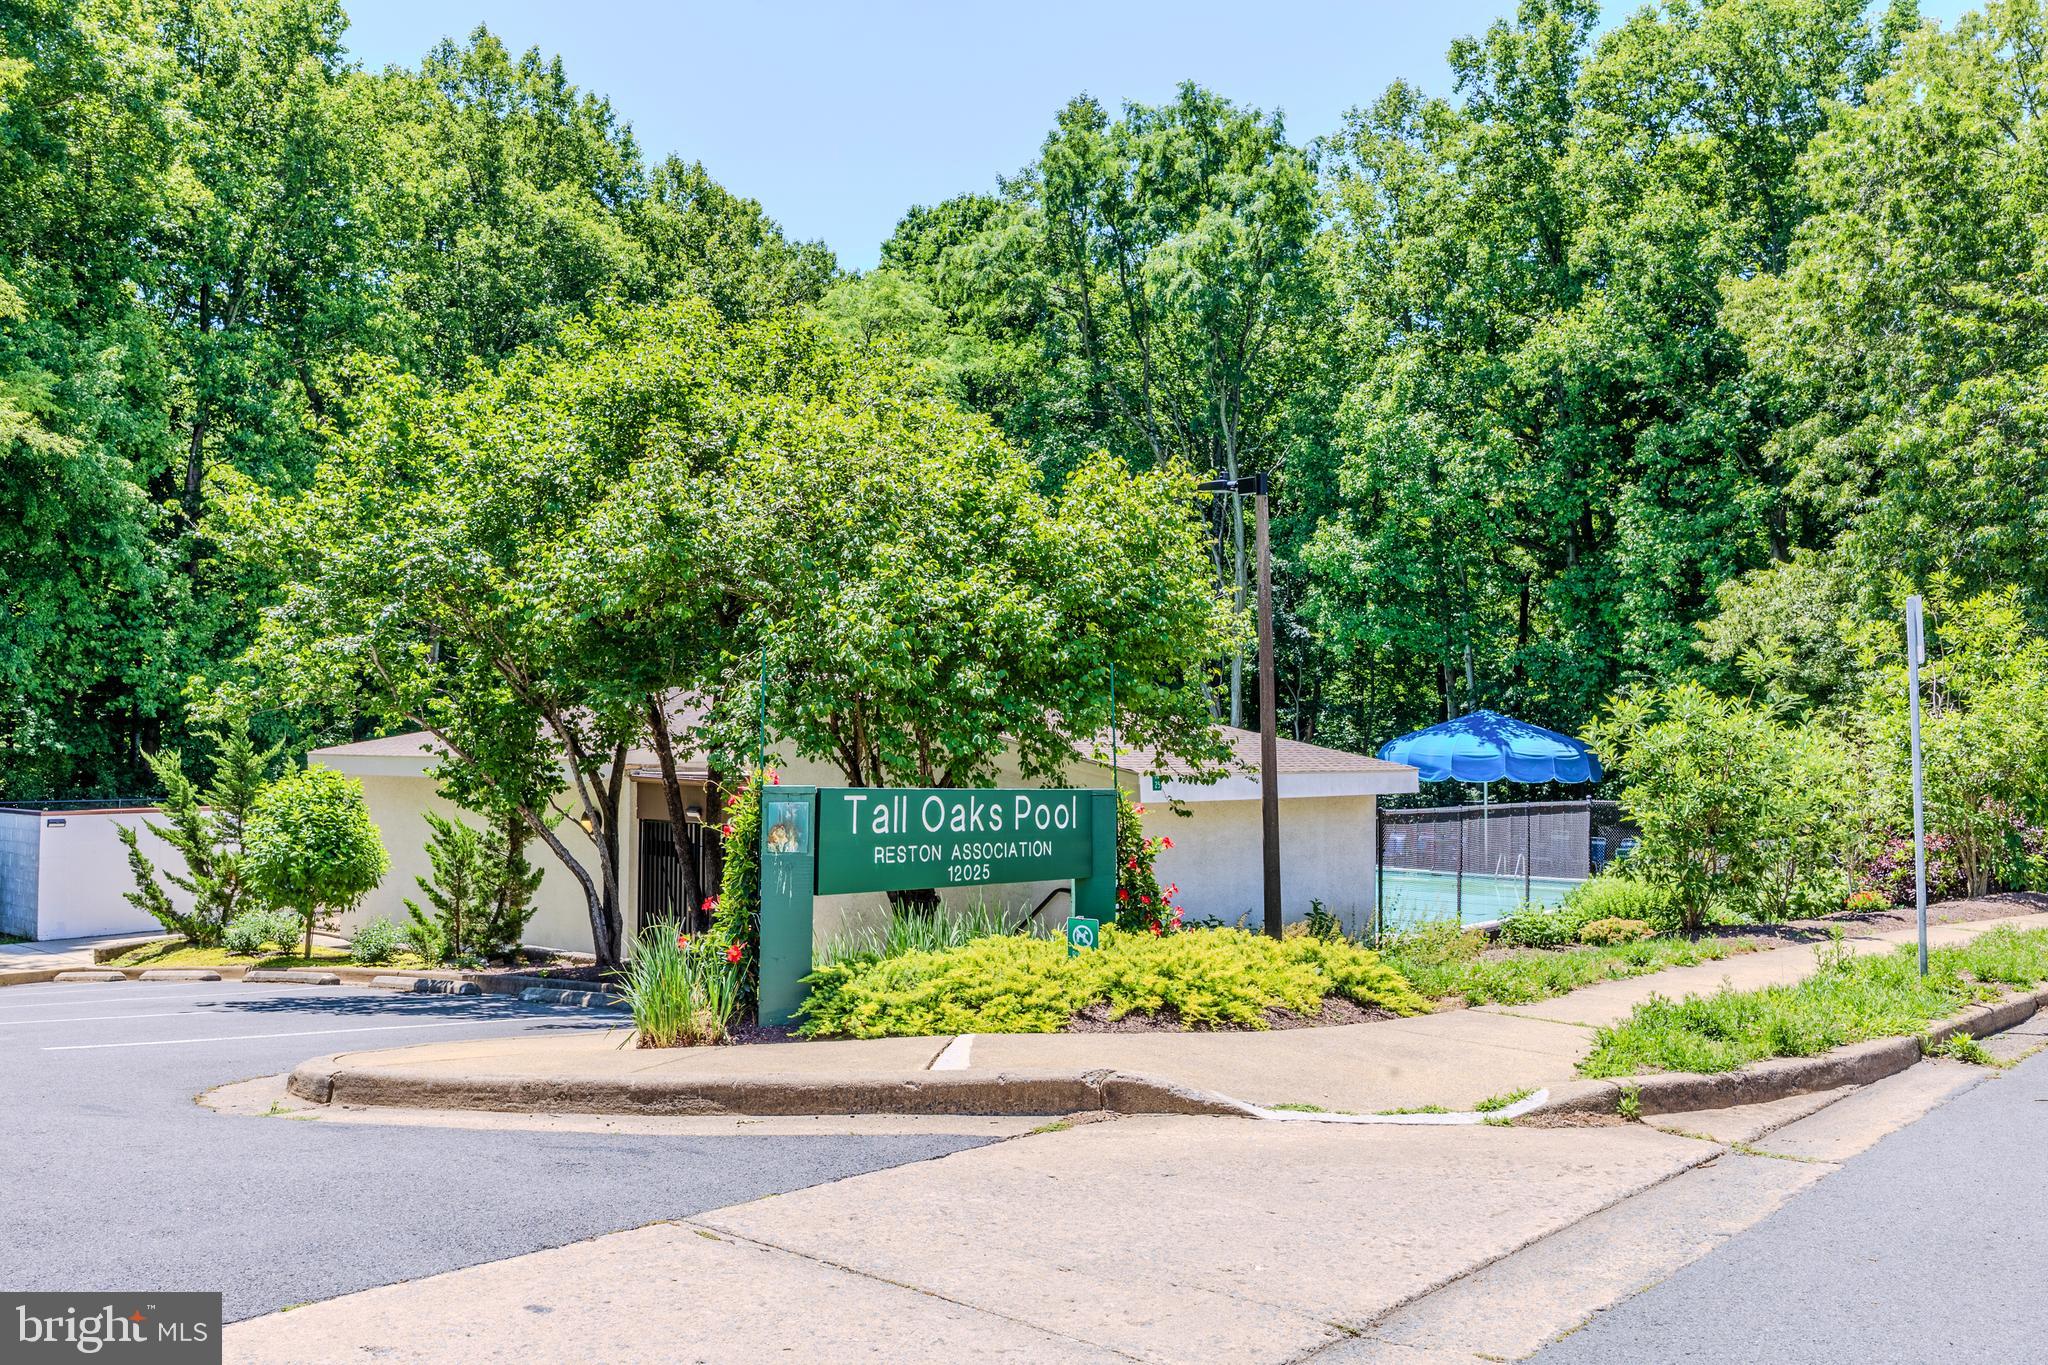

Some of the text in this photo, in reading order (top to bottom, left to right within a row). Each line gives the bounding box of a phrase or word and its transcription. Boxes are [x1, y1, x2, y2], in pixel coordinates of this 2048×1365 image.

[843, 795, 1077, 835] Tall Oaks Pool
[874, 841, 1052, 864] RESTON ASSOCIATION
[947, 863, 990, 882] 12025
